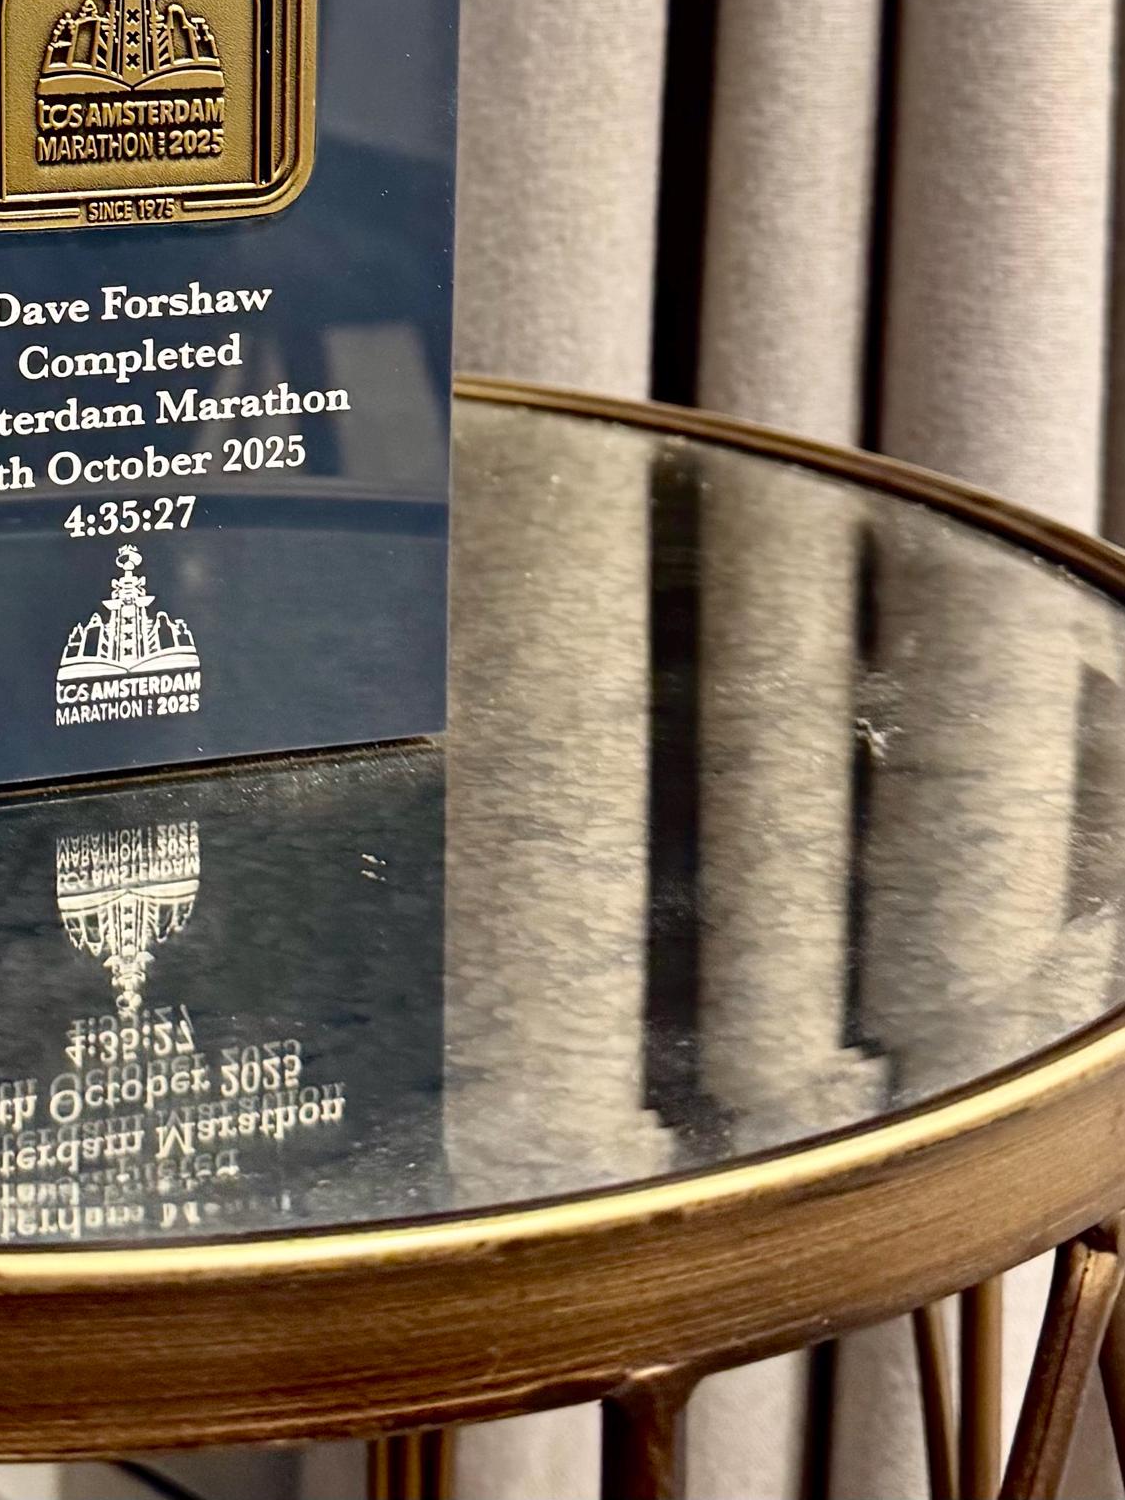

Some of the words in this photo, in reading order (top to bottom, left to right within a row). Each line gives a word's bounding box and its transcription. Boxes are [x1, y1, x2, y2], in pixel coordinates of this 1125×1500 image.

[85, 97, 225, 128] AMSTERDAM
[37, 131, 154, 162] MARATHON
[169, 128, 225, 156] 2025
[87, 200, 133, 222] SINCE
[138, 197, 176, 220] 1975
[100, 281, 273, 321] Forshaw
[18, 333, 242, 384] Completed
[155, 382, 351, 425] Marathon
[47, 445, 213, 486] October
[222, 434, 307, 473] 2025
[63, 495, 197, 539] 4:35:27
[91, 672, 201, 702] AMSTERDAM
[56, 700, 143, 726] MARATHON
[157, 693, 200, 716] 2025
